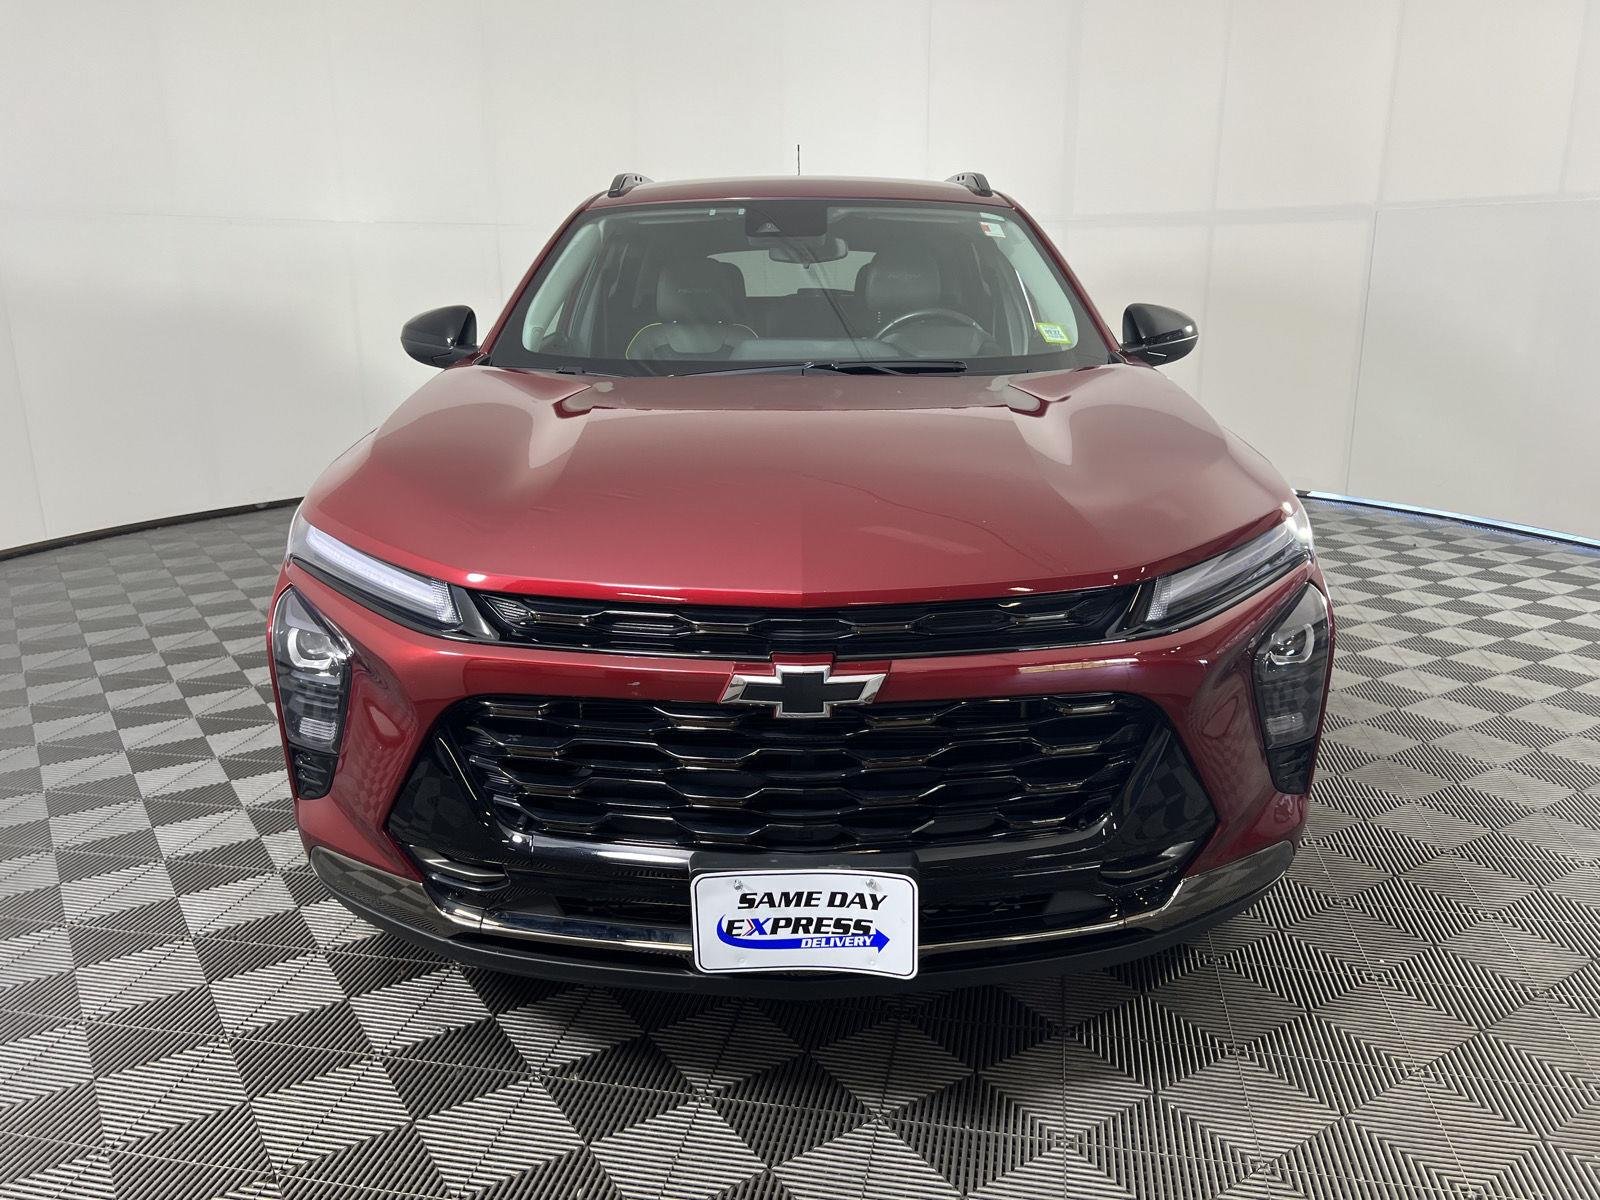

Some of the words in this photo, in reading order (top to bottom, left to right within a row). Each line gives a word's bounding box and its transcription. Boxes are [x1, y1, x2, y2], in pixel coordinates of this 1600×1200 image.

[737, 891, 823, 910] SAME
[827, 891, 888, 911] DAY
[725, 916, 875, 937] EXPRESS
[800, 935, 875, 949] DELIVERY
